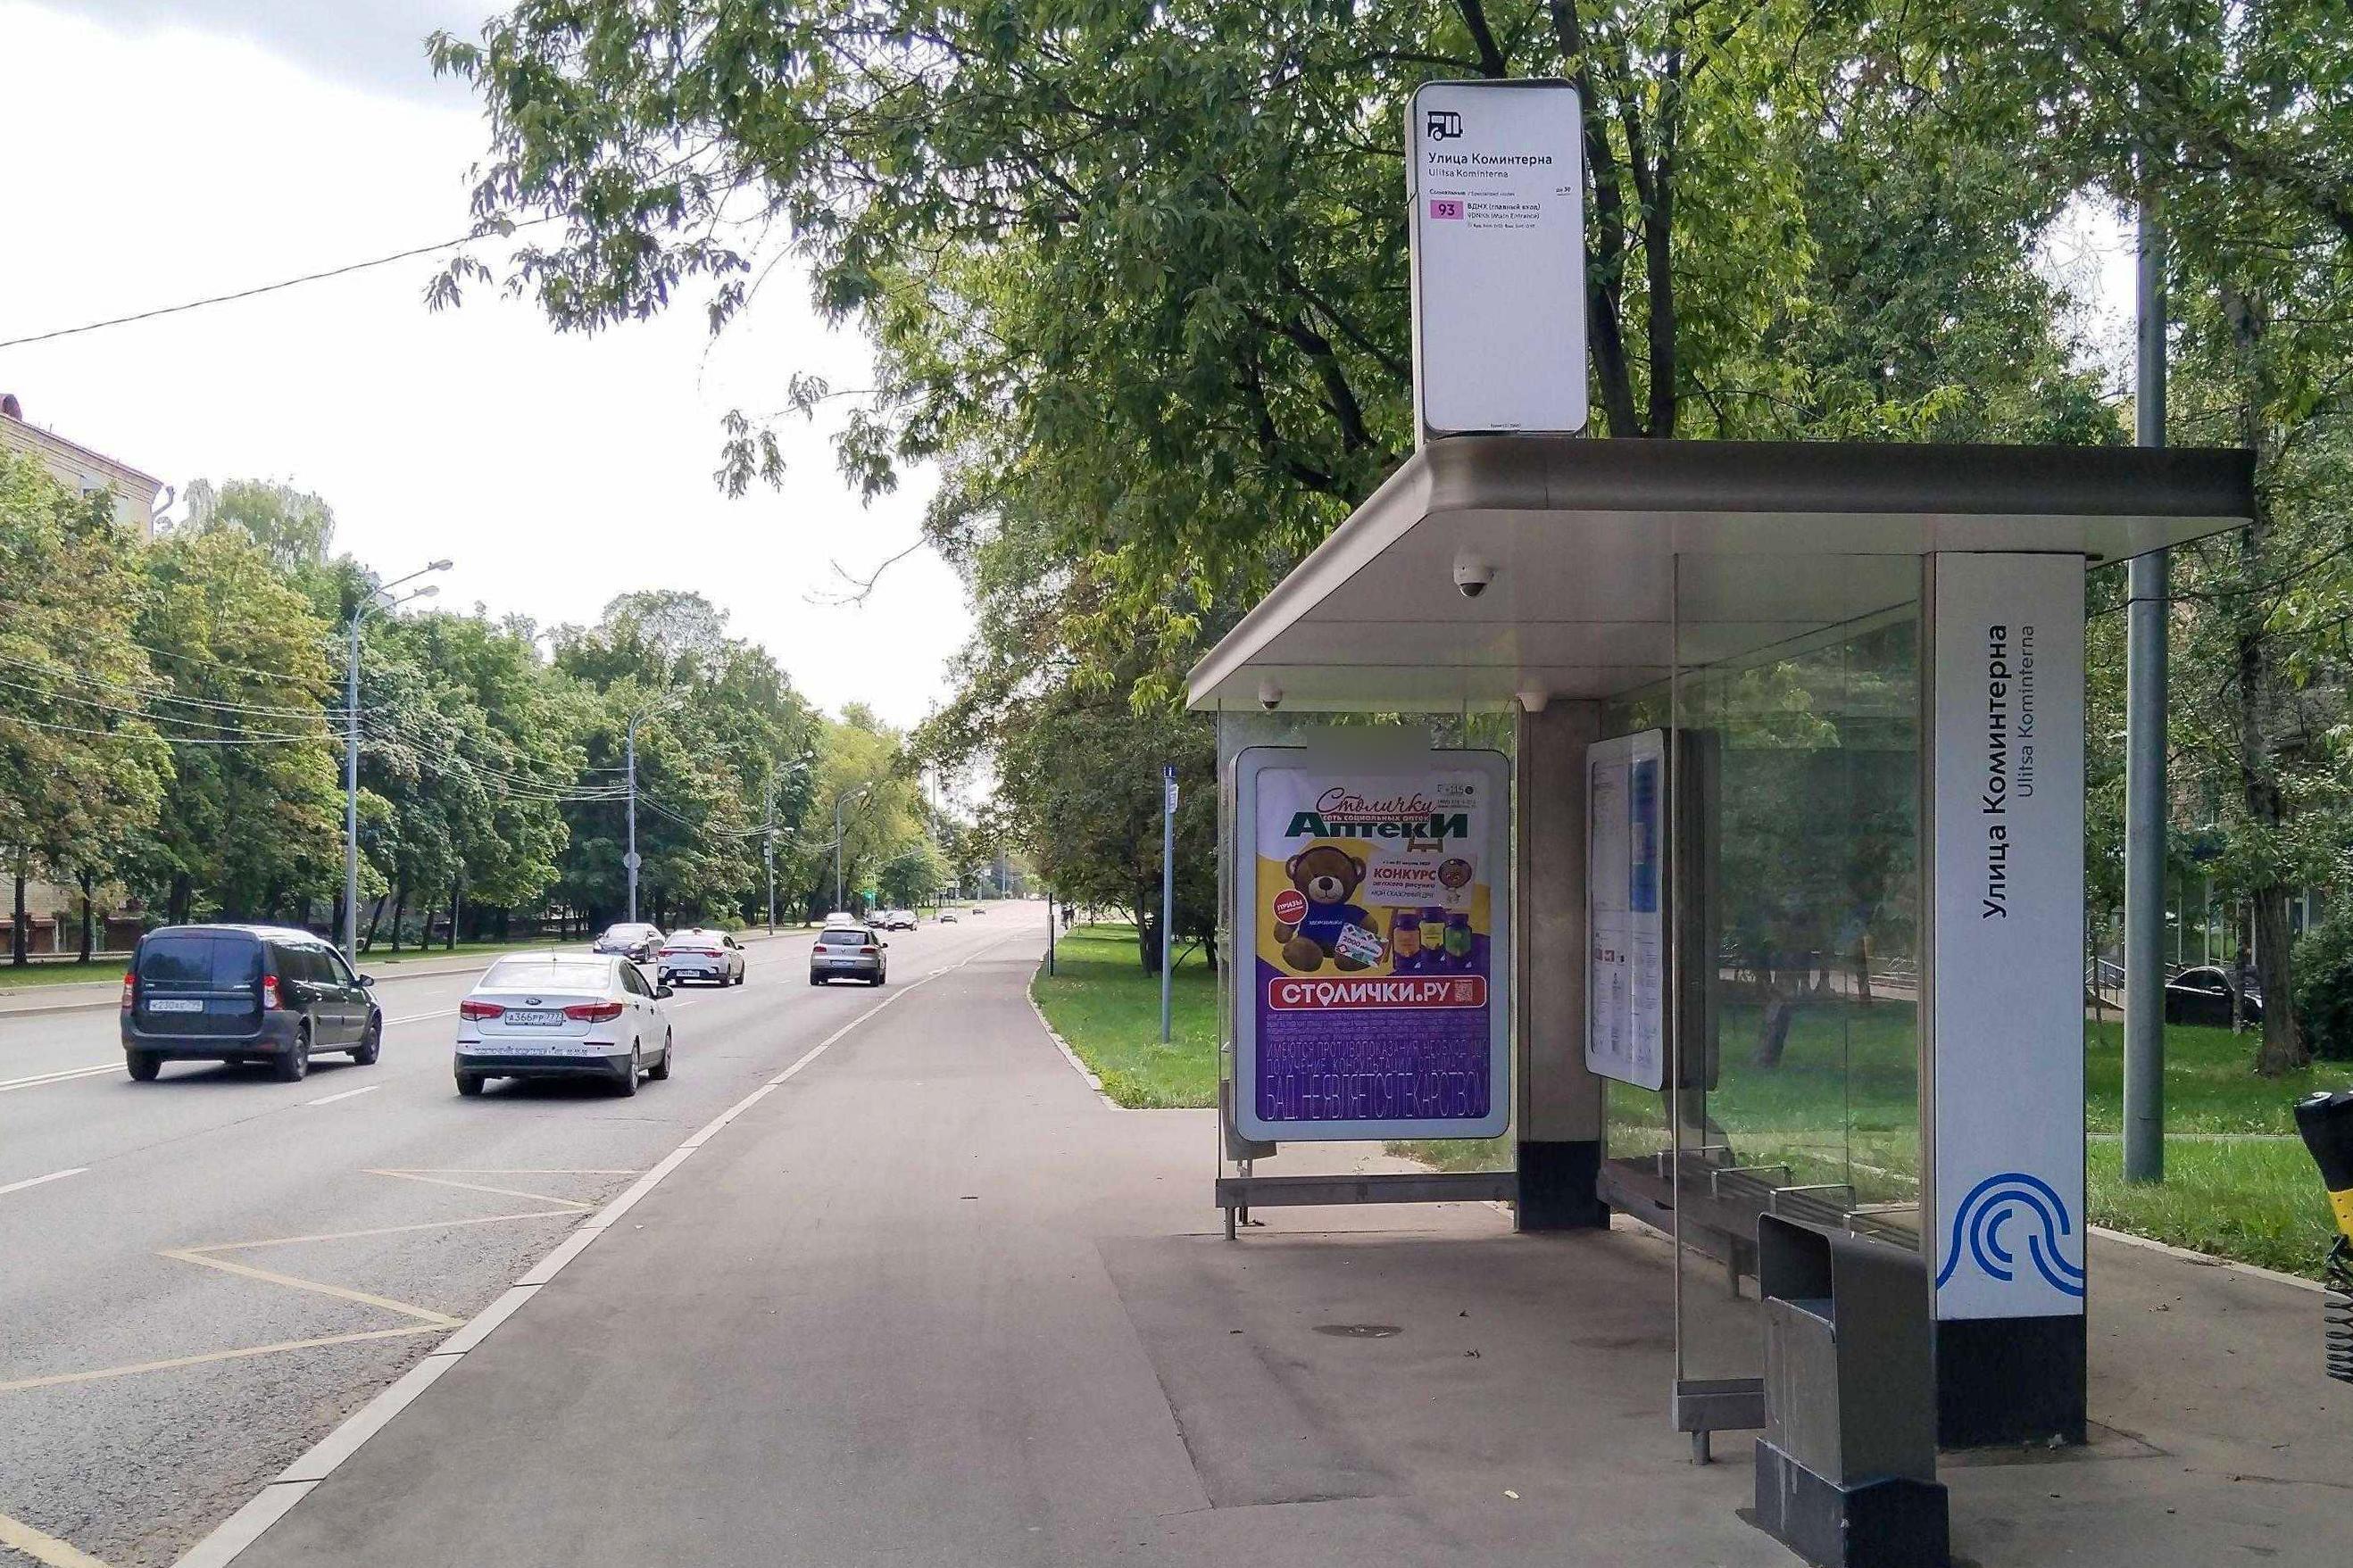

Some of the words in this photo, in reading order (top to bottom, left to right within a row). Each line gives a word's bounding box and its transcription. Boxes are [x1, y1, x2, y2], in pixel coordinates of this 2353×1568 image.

[1428, 153, 1468, 166] Улица
[1473, 153, 1552, 167] Коминтерна
[1428, 169, 1455, 178] Ulitsa
[1456, 170, 1509, 178] Kominterna
[1438, 203, 1455, 216] 93
[1468, 203, 1487, 211] ВДНХ
[2017, 625, 2035, 739] Kominterna
[1983, 624, 2013, 815] Коминтерна
[2017, 745, 2033, 799] Ulitsa
[1316, 787, 1437, 814] Столички
[1343, 814, 1401, 823] социальных
[1402, 815, 1430, 823] аптек
[1374, 867, 1437, 881] КОНКУРС
[1983, 824, 2010, 920] Улица
[1276, 899, 1302, 911] ПРИЗЫ
[1282, 982, 1451, 1007] СТОЛИЧКИ.РУ
[1267, 1041, 1315, 1058] ИМЕЮТСЯ
[1301, 1073, 1320, 1119] НЕ
[1322, 1072, 1393, 1119] ЯВЛЯЕТСЯ
[1394, 1071, 1489, 1116] ЛЕКАРСТВОМ
